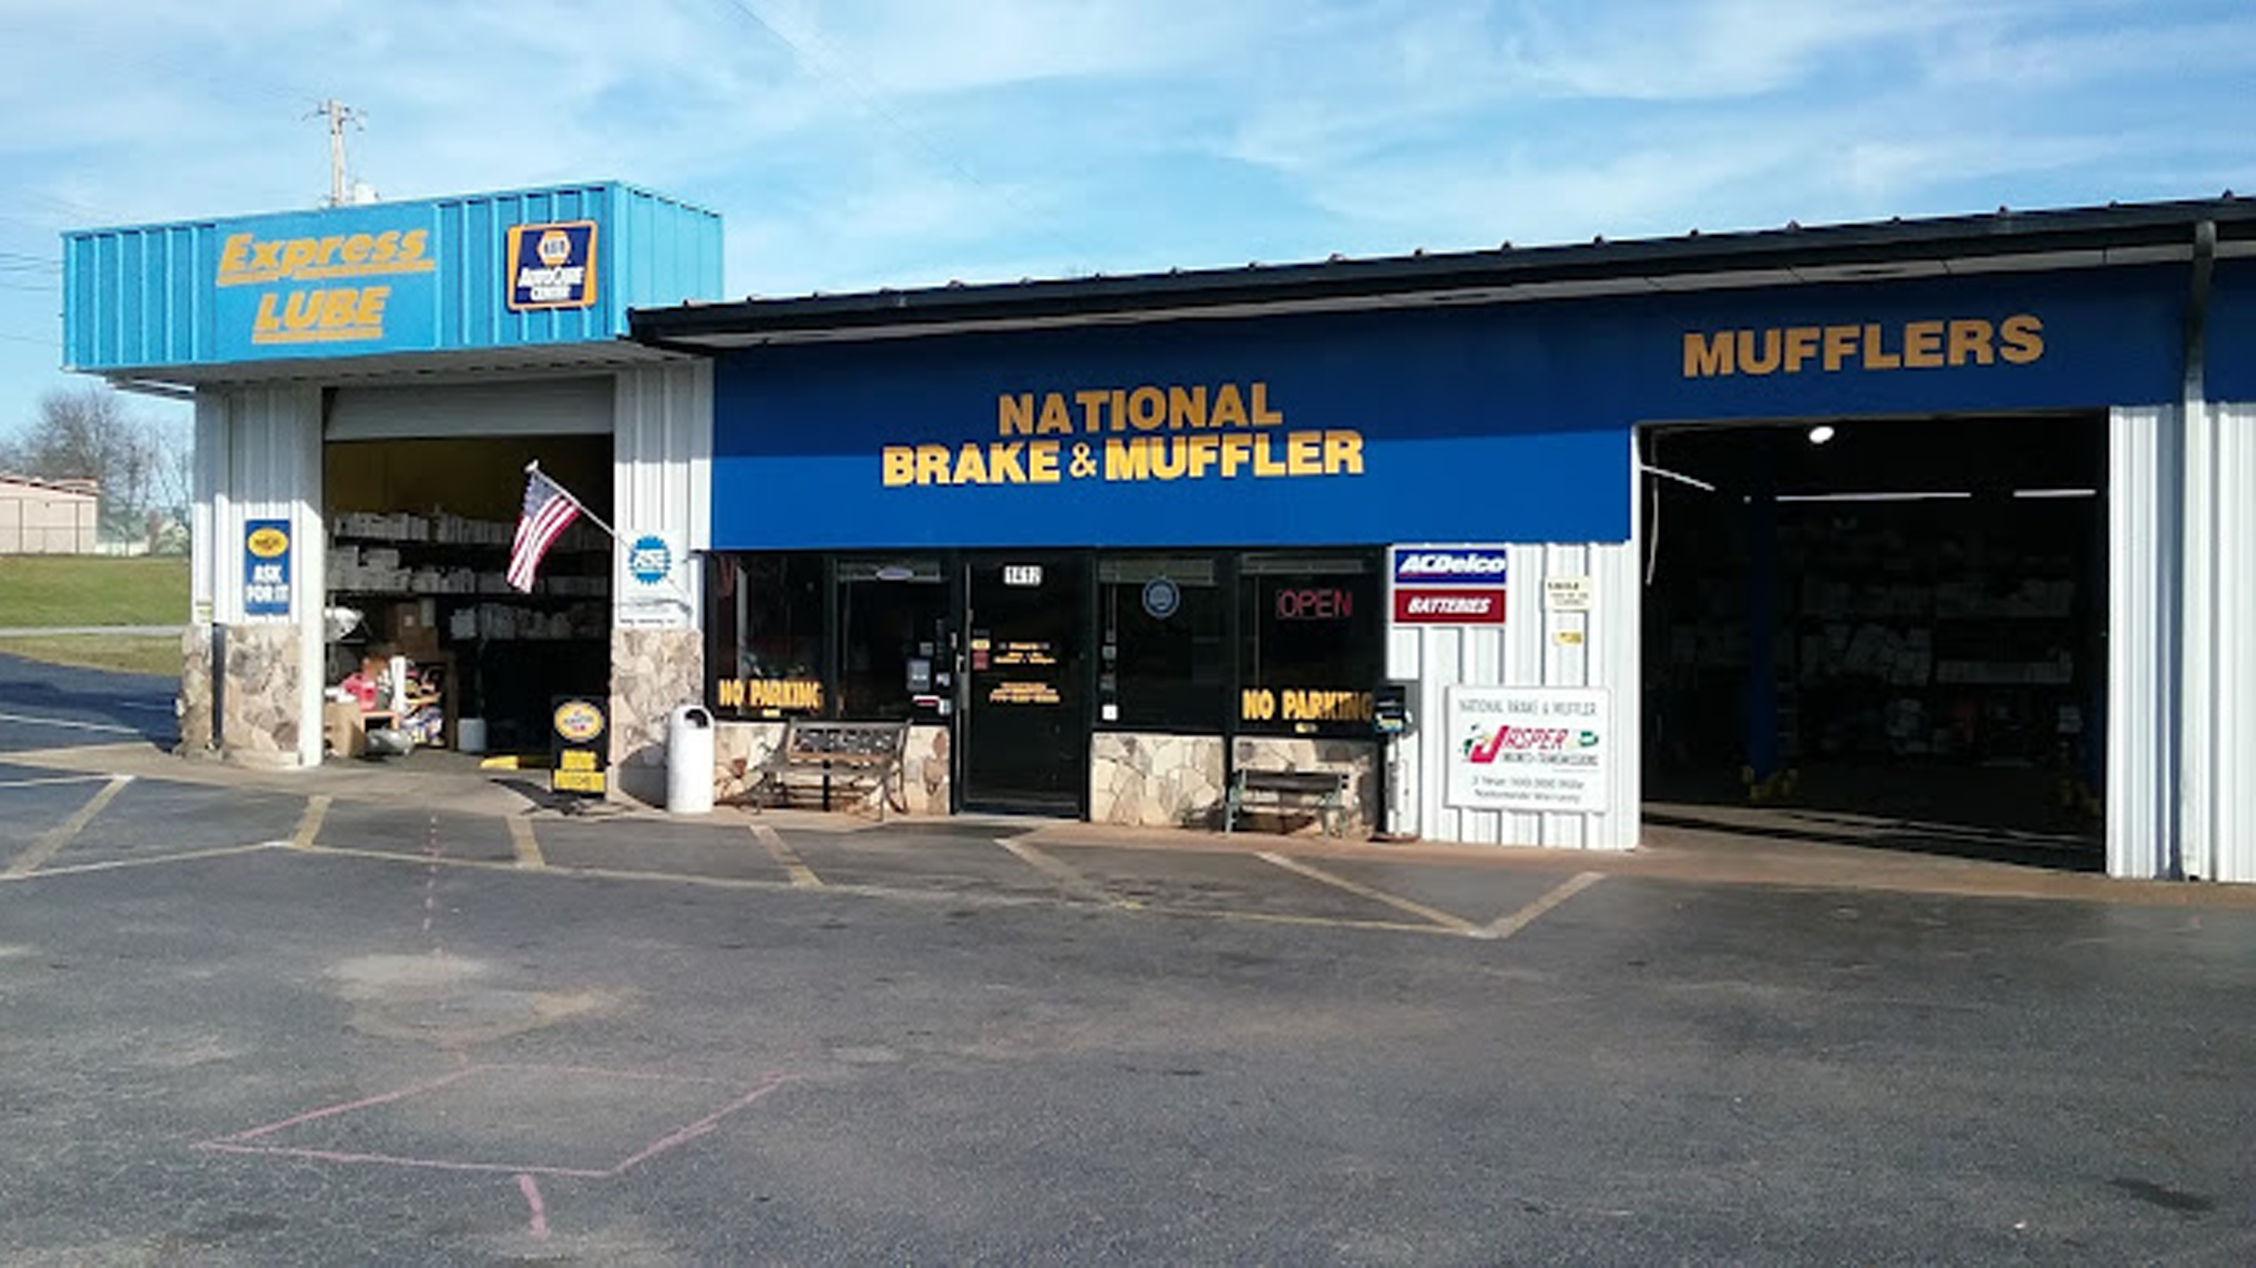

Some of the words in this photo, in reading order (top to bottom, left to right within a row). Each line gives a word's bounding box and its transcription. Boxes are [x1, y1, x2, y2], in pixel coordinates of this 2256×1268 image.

[218, 229, 429, 276] Express
[254, 286, 391, 330] LUBE
[1682, 314, 2045, 378] MUFFLERS
[998, 382, 1283, 436] NATIONAL
[882, 440, 1062, 487] BRAKE
[1069, 441, 1098, 479] &
[1104, 429, 1365, 482] MUFFLER
[1398, 552, 1506, 573] ACDelco
[1277, 588, 1353, 618] OPEN
[1407, 596, 1492, 615] BATTERIES
[718, 678, 743, 707] NO
[749, 678, 823, 709] PARKING
[1242, 688, 1275, 720] NO
[1281, 689, 1374, 721] PARKING
[1470, 725, 1569, 764] JASPER
